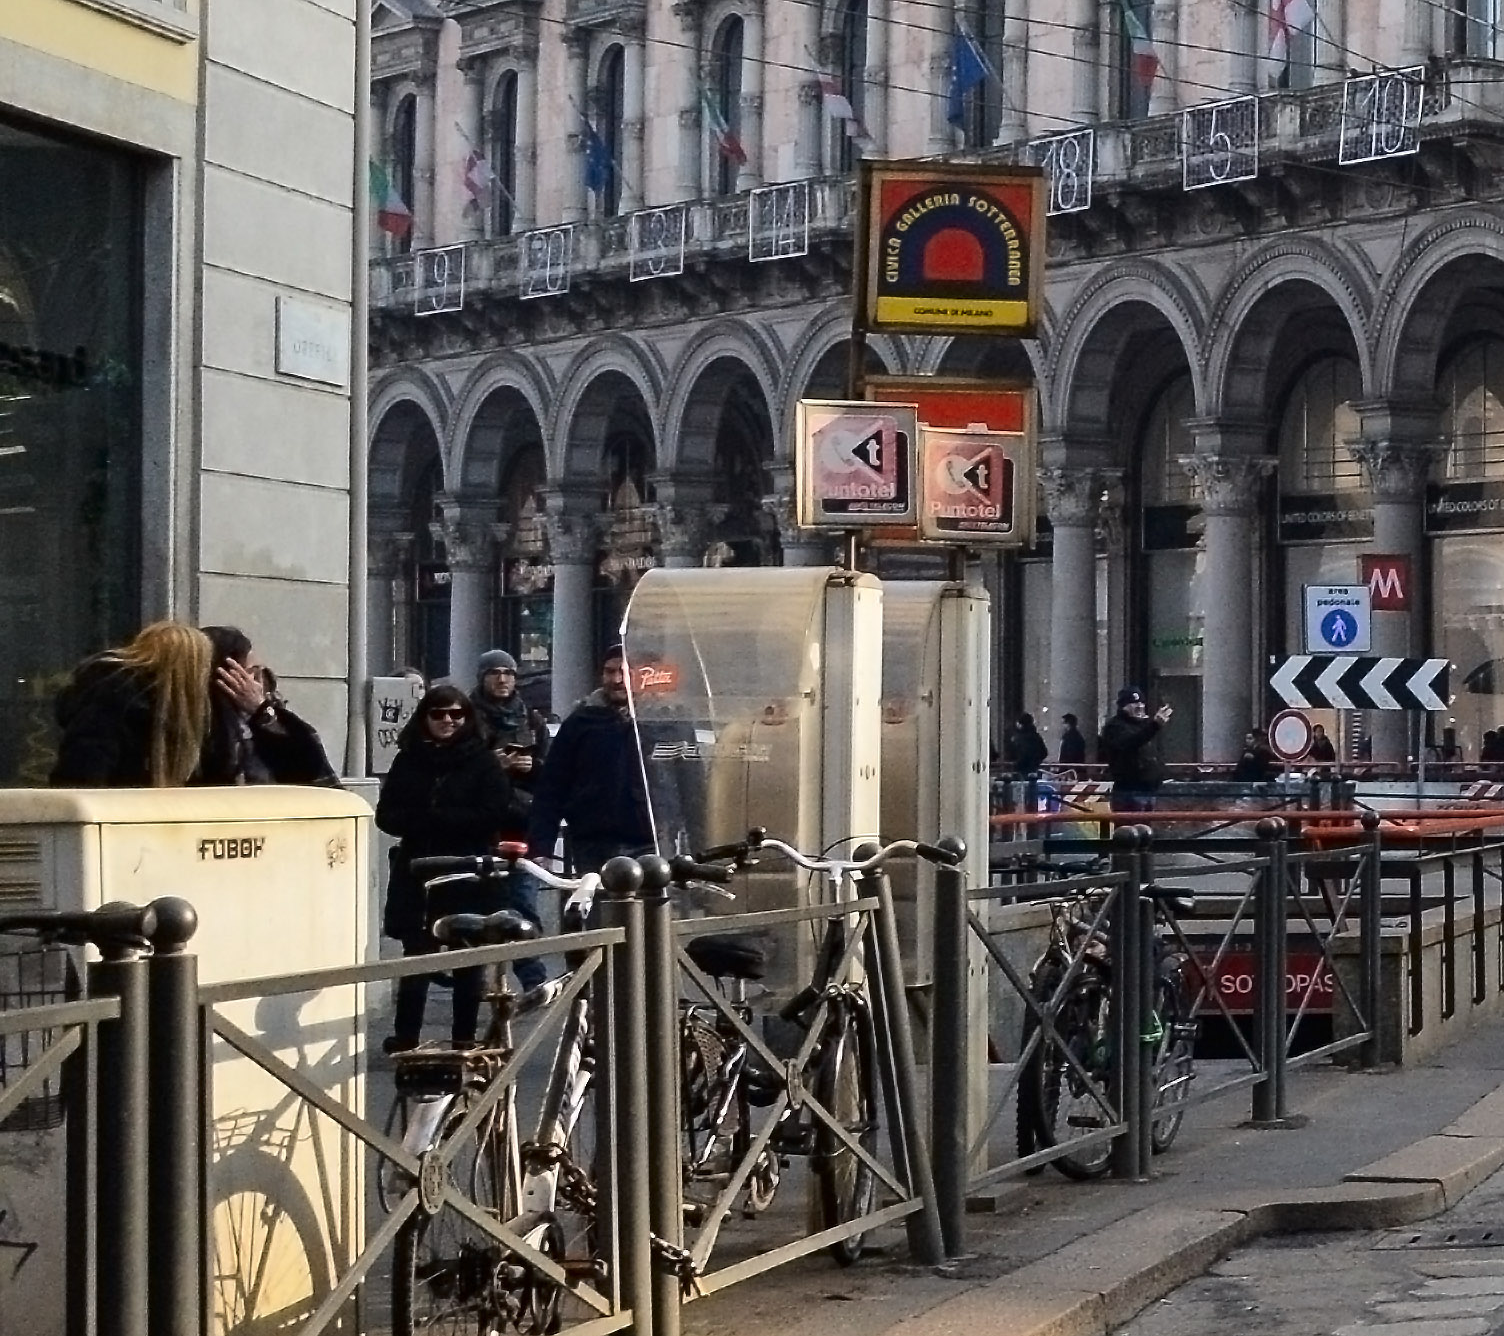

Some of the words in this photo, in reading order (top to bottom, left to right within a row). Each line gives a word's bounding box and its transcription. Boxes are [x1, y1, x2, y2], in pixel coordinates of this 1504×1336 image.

[1209, 104, 1232, 180] 5
[1361, 76, 1407, 155] 10
[1041, 138, 1080, 209] 18
[886, 237, 901, 282] CIVICA
[896, 193, 960, 232] GALLERIA
[967, 196, 1021, 286] SOTTERRANEA
[433, 252, 448, 309] 9
[930, 502, 1000, 518] Puntotel
[1317, 598, 1360, 607] pedonale
[1371, 568, 1404, 598] M
